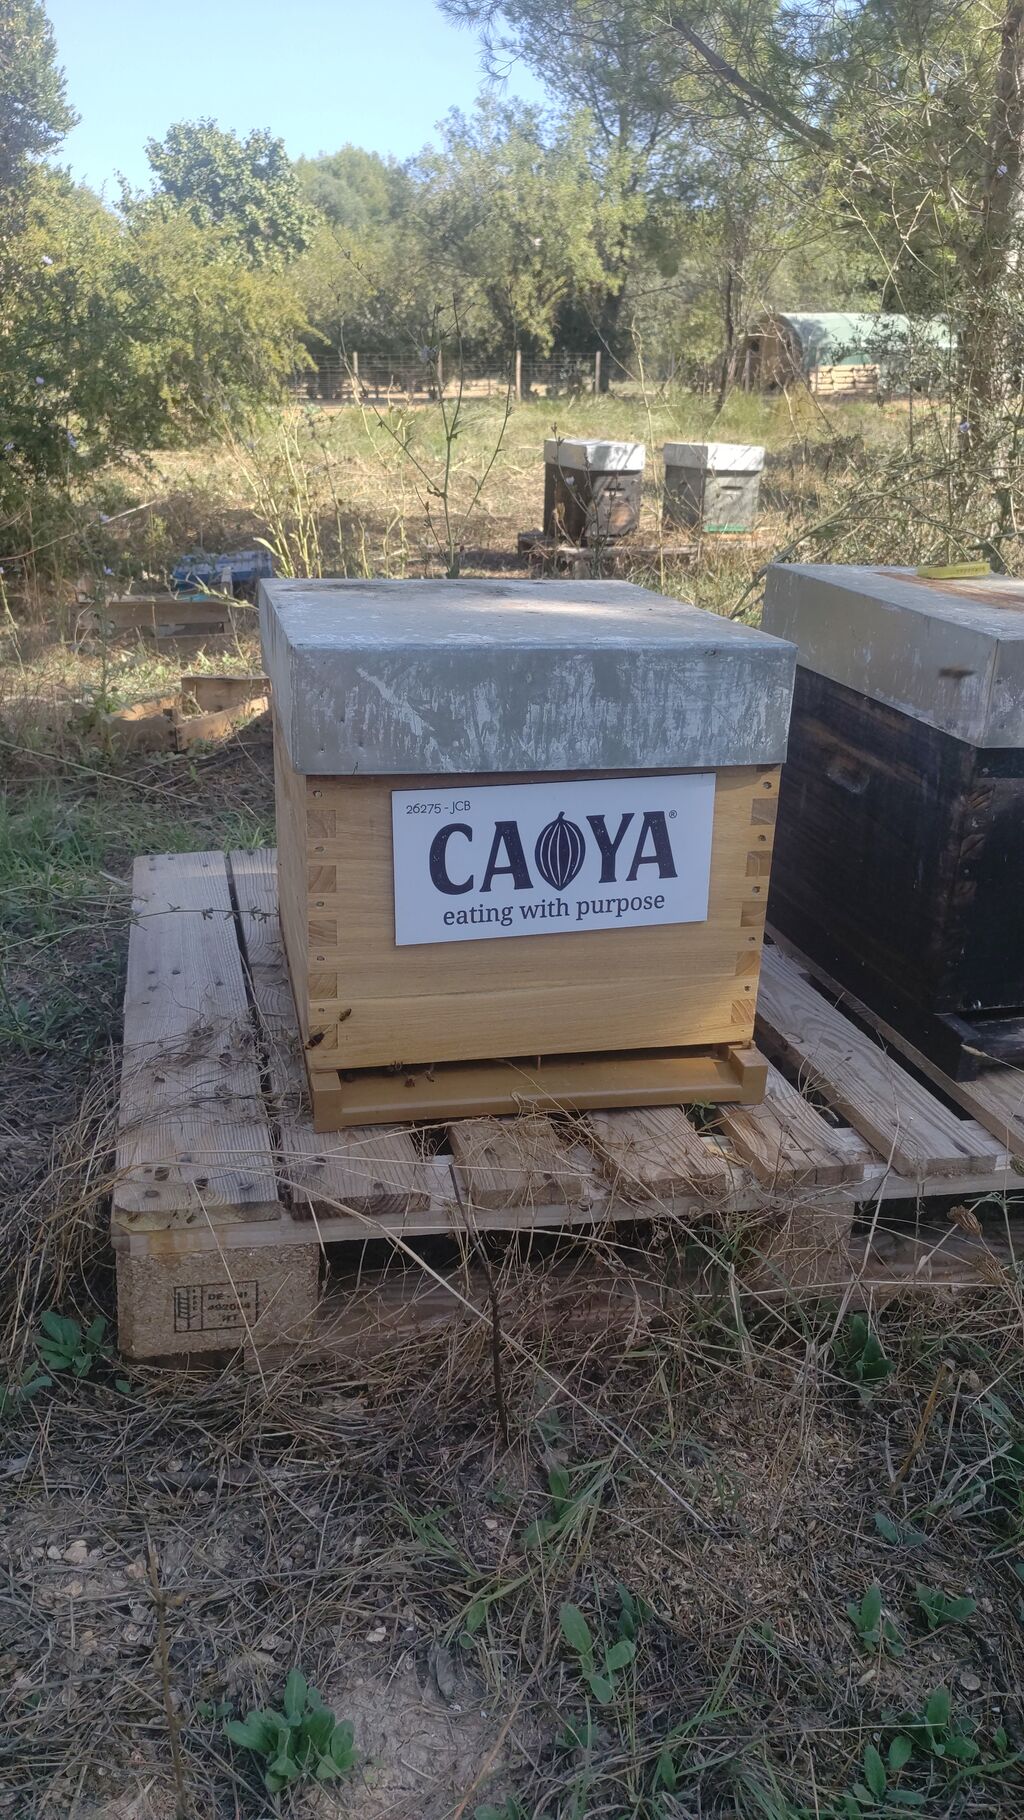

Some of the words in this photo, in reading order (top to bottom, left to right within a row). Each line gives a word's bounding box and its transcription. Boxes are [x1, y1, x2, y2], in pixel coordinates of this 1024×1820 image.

[406, 803, 442, 815] 26275
[450, 800, 472, 815] JCB
[443, 903, 514, 927] eating
[519, 898, 570, 920] with
[576, 894, 666, 921] purpose
